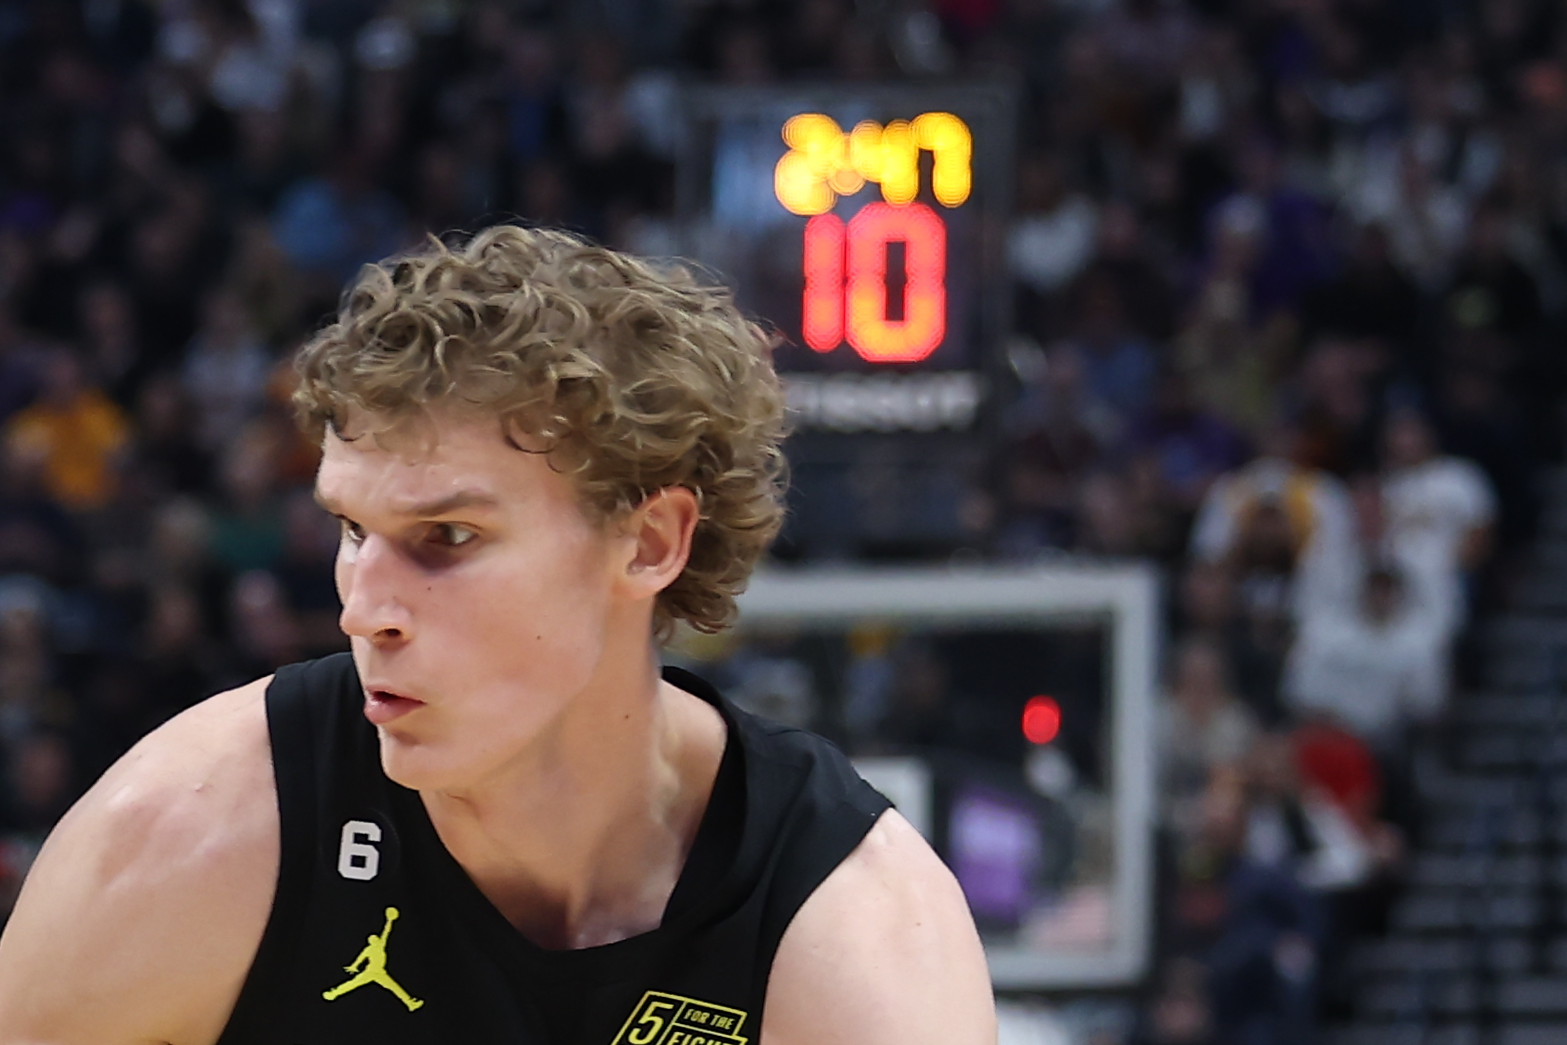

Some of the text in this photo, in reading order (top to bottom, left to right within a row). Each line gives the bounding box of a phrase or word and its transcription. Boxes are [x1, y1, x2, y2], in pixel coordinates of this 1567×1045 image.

[802, 202, 947, 362] 10
[336, 819, 382, 881] 6
[627, 1001, 675, 1045] 5
[683, 1008, 735, 1030] FOR THE
